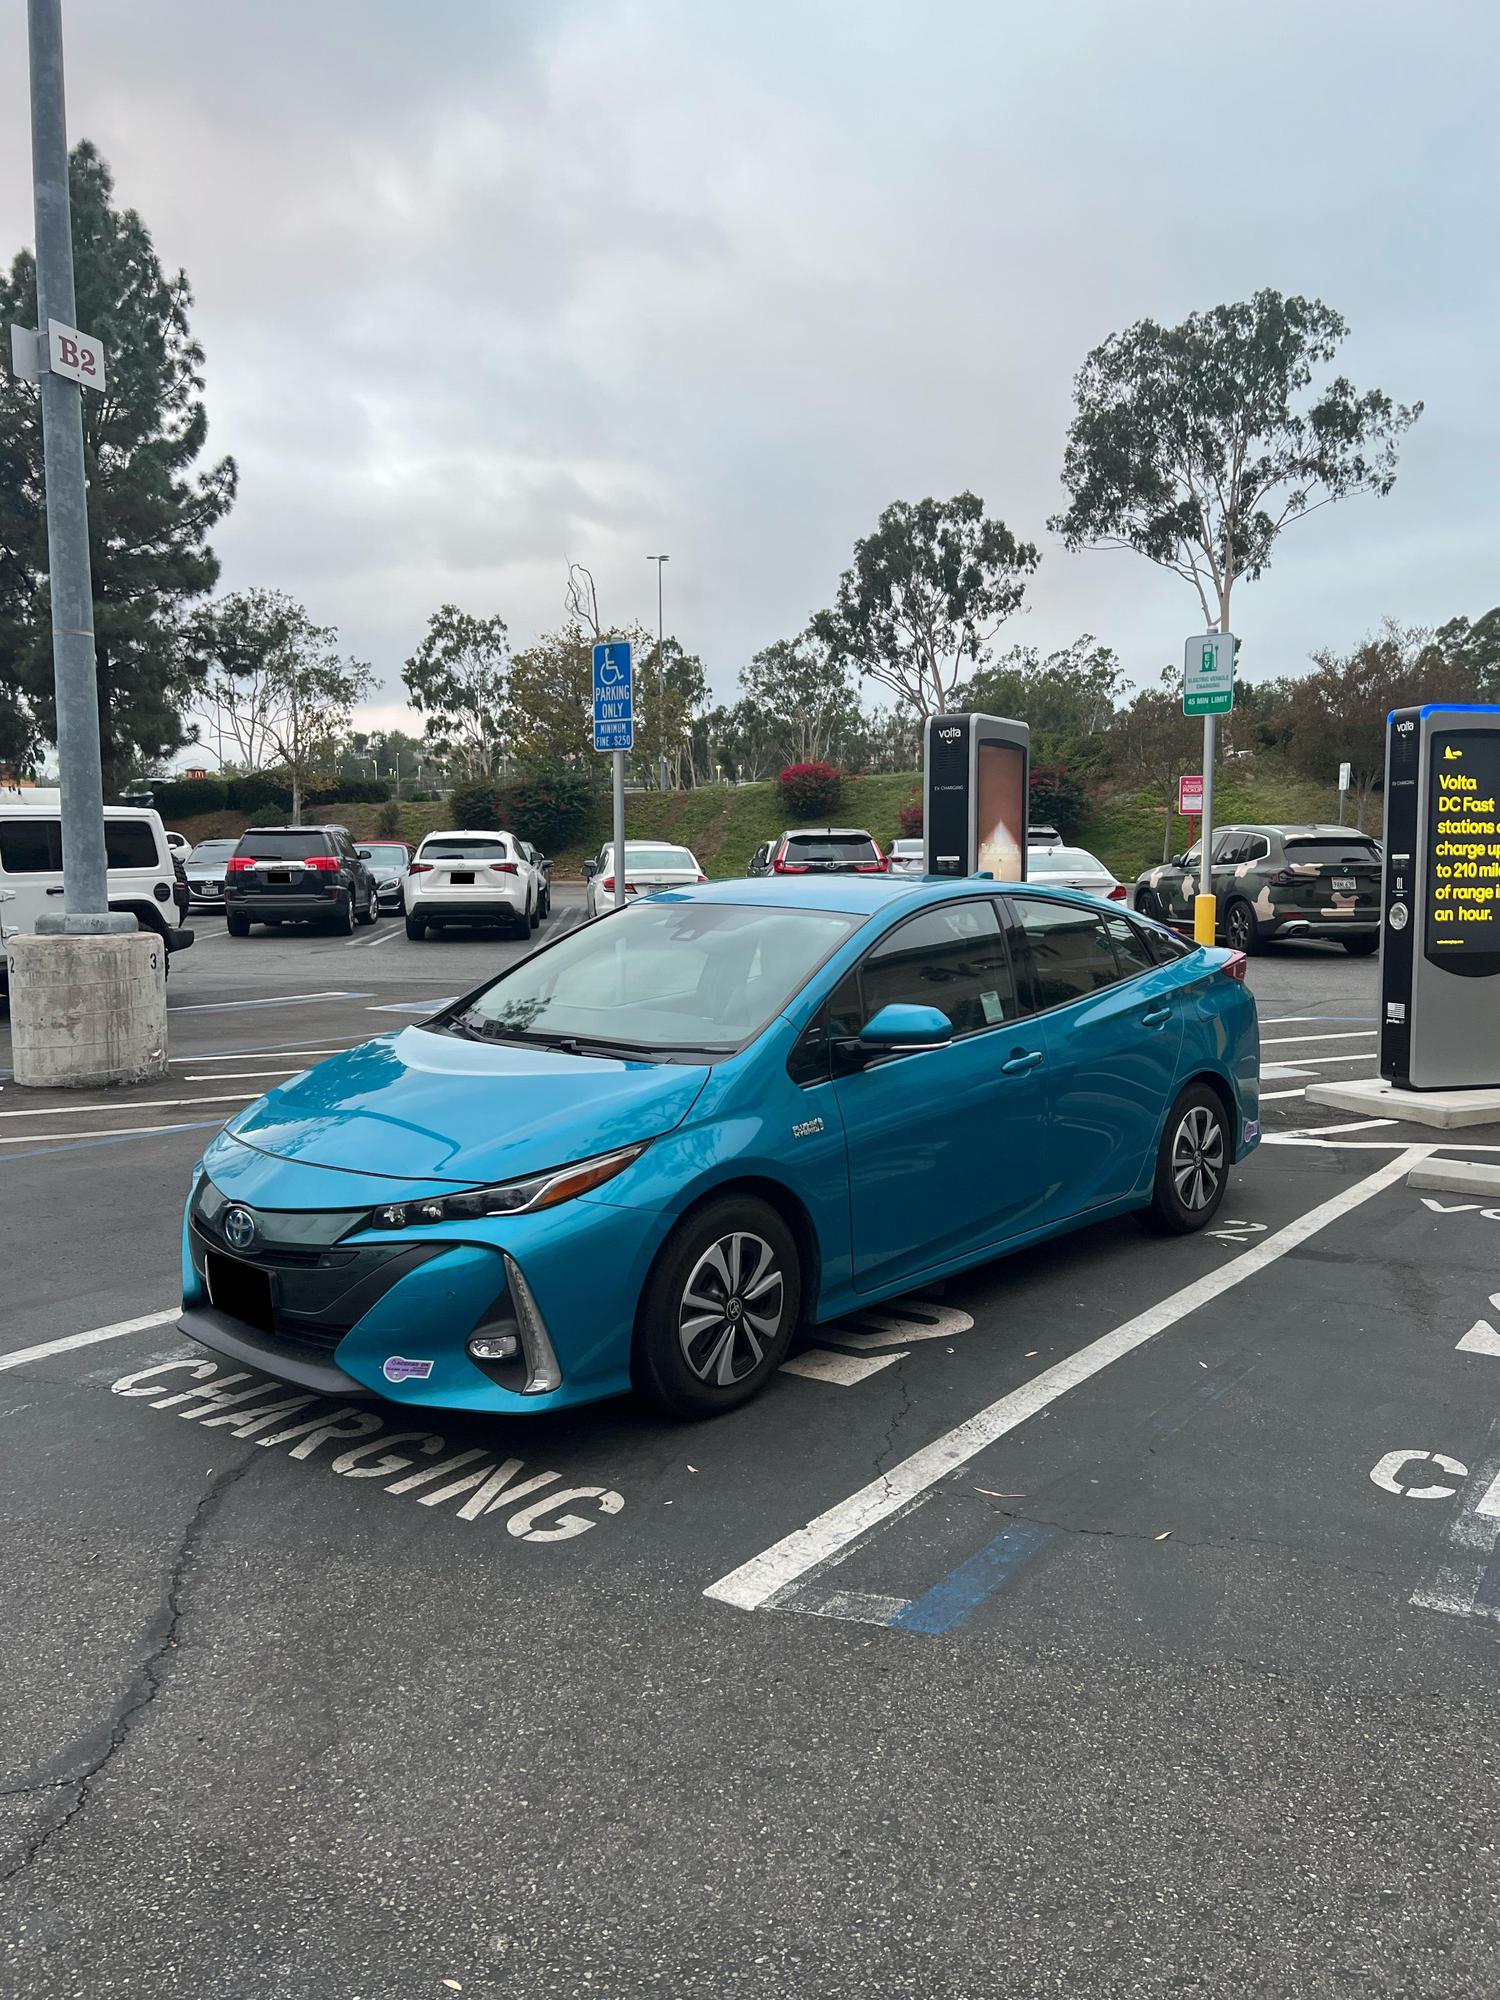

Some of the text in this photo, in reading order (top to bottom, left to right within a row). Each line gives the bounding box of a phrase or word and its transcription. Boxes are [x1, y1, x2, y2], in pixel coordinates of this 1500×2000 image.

[58, 335, 96, 376] B2
[595, 685, 630, 701] PARKING
[1187, 695, 1228, 705] 45 MIN LIMIT
[601, 702, 624, 719] ONLY
[600, 723, 627, 735] MINIMUM
[938, 727, 962, 738] volta
[1396, 720, 1414, 732] volta
[596, 735, 631, 747] FINE $250
[1439, 774, 1477, 790] Volta
[1438, 796, 1495, 812] DC Fast
[1437, 819, 1495, 834] stations
[1435, 840, 1486, 860] charge
[1436, 862, 1500, 878] to 210 mil
[1435, 884, 1452, 900] of
[1452, 887, 1494, 904] range
[1434, 905, 1493, 921] an hour.
[150, 953, 157, 970] 3
[110, 1359, 625, 1543] CHARGING
